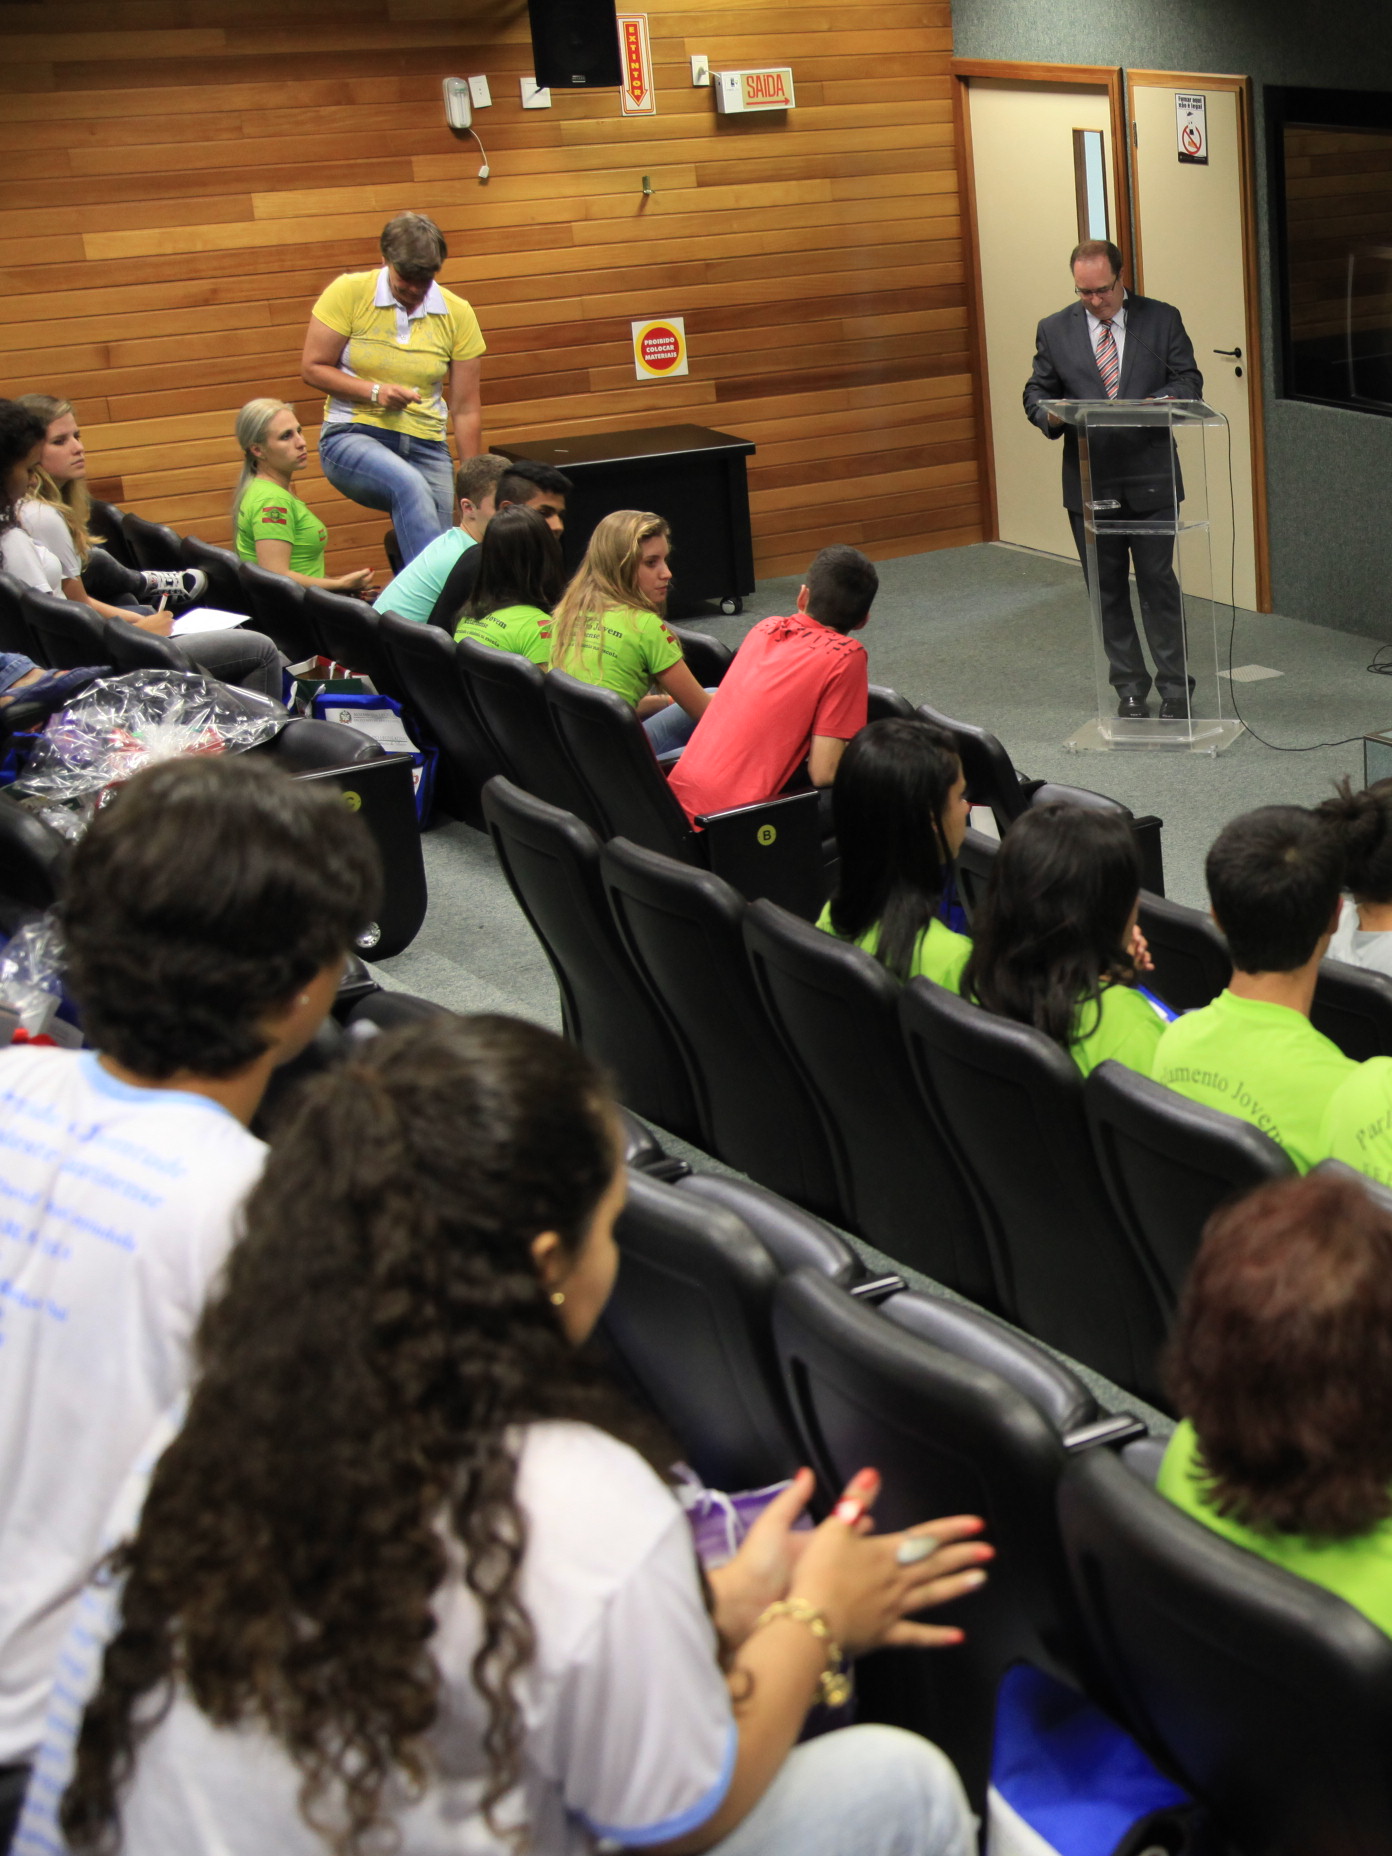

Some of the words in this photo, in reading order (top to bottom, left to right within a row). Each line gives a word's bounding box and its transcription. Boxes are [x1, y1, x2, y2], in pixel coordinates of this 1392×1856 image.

[628, 26, 642, 97] EXTINTOR
[746, 74, 785, 99] SAÍDA
[644, 337, 675, 345] PROIBIDO
[645, 352, 677, 360] MATERIAIS
[486, 613, 507, 629] Jovem
